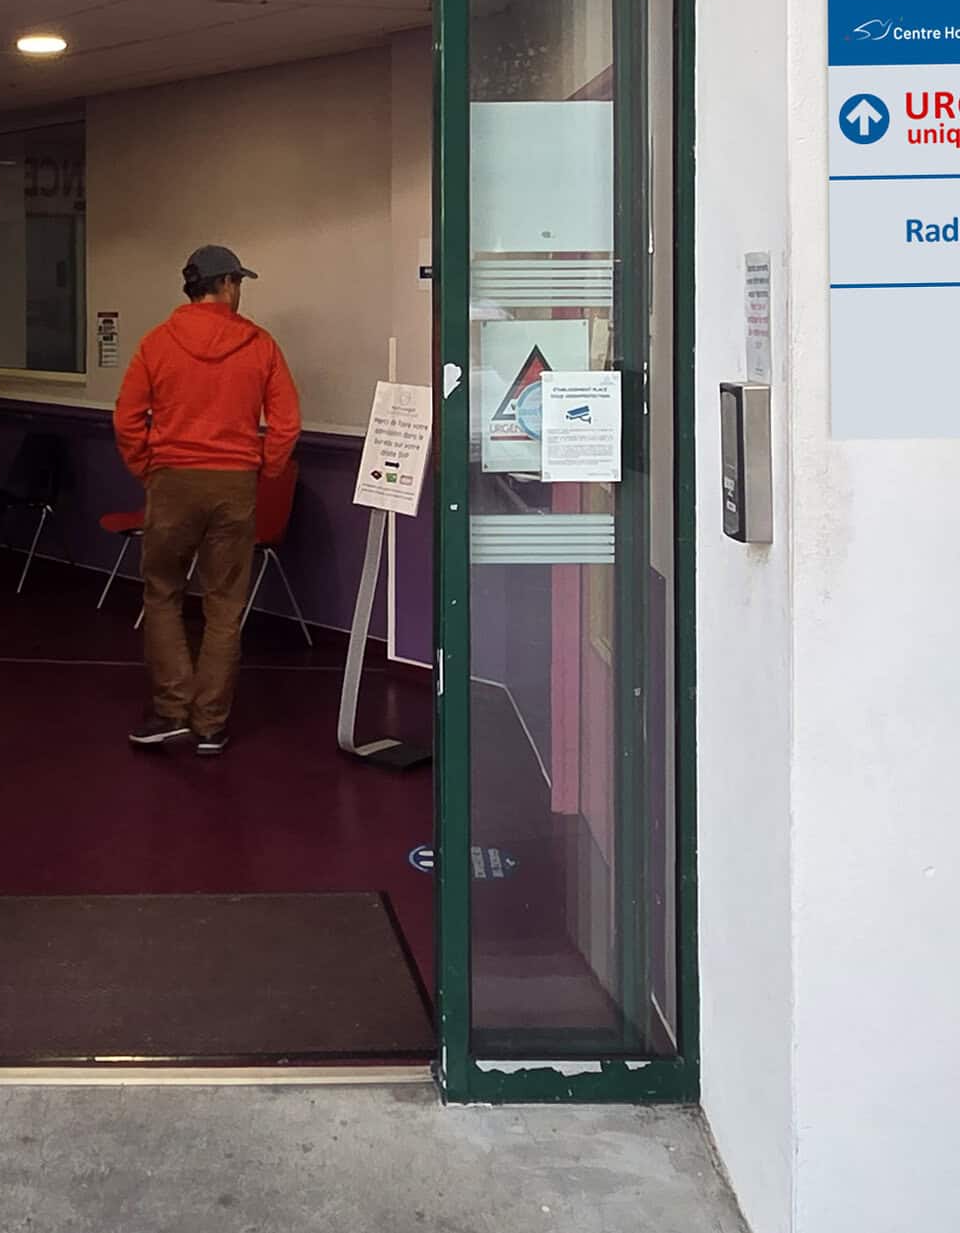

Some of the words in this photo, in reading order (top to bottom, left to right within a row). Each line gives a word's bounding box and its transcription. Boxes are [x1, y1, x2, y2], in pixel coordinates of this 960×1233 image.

[893, 27, 941, 40] Centre
[905, 91, 960, 120] UR
[906, 216, 959, 243] Rad
